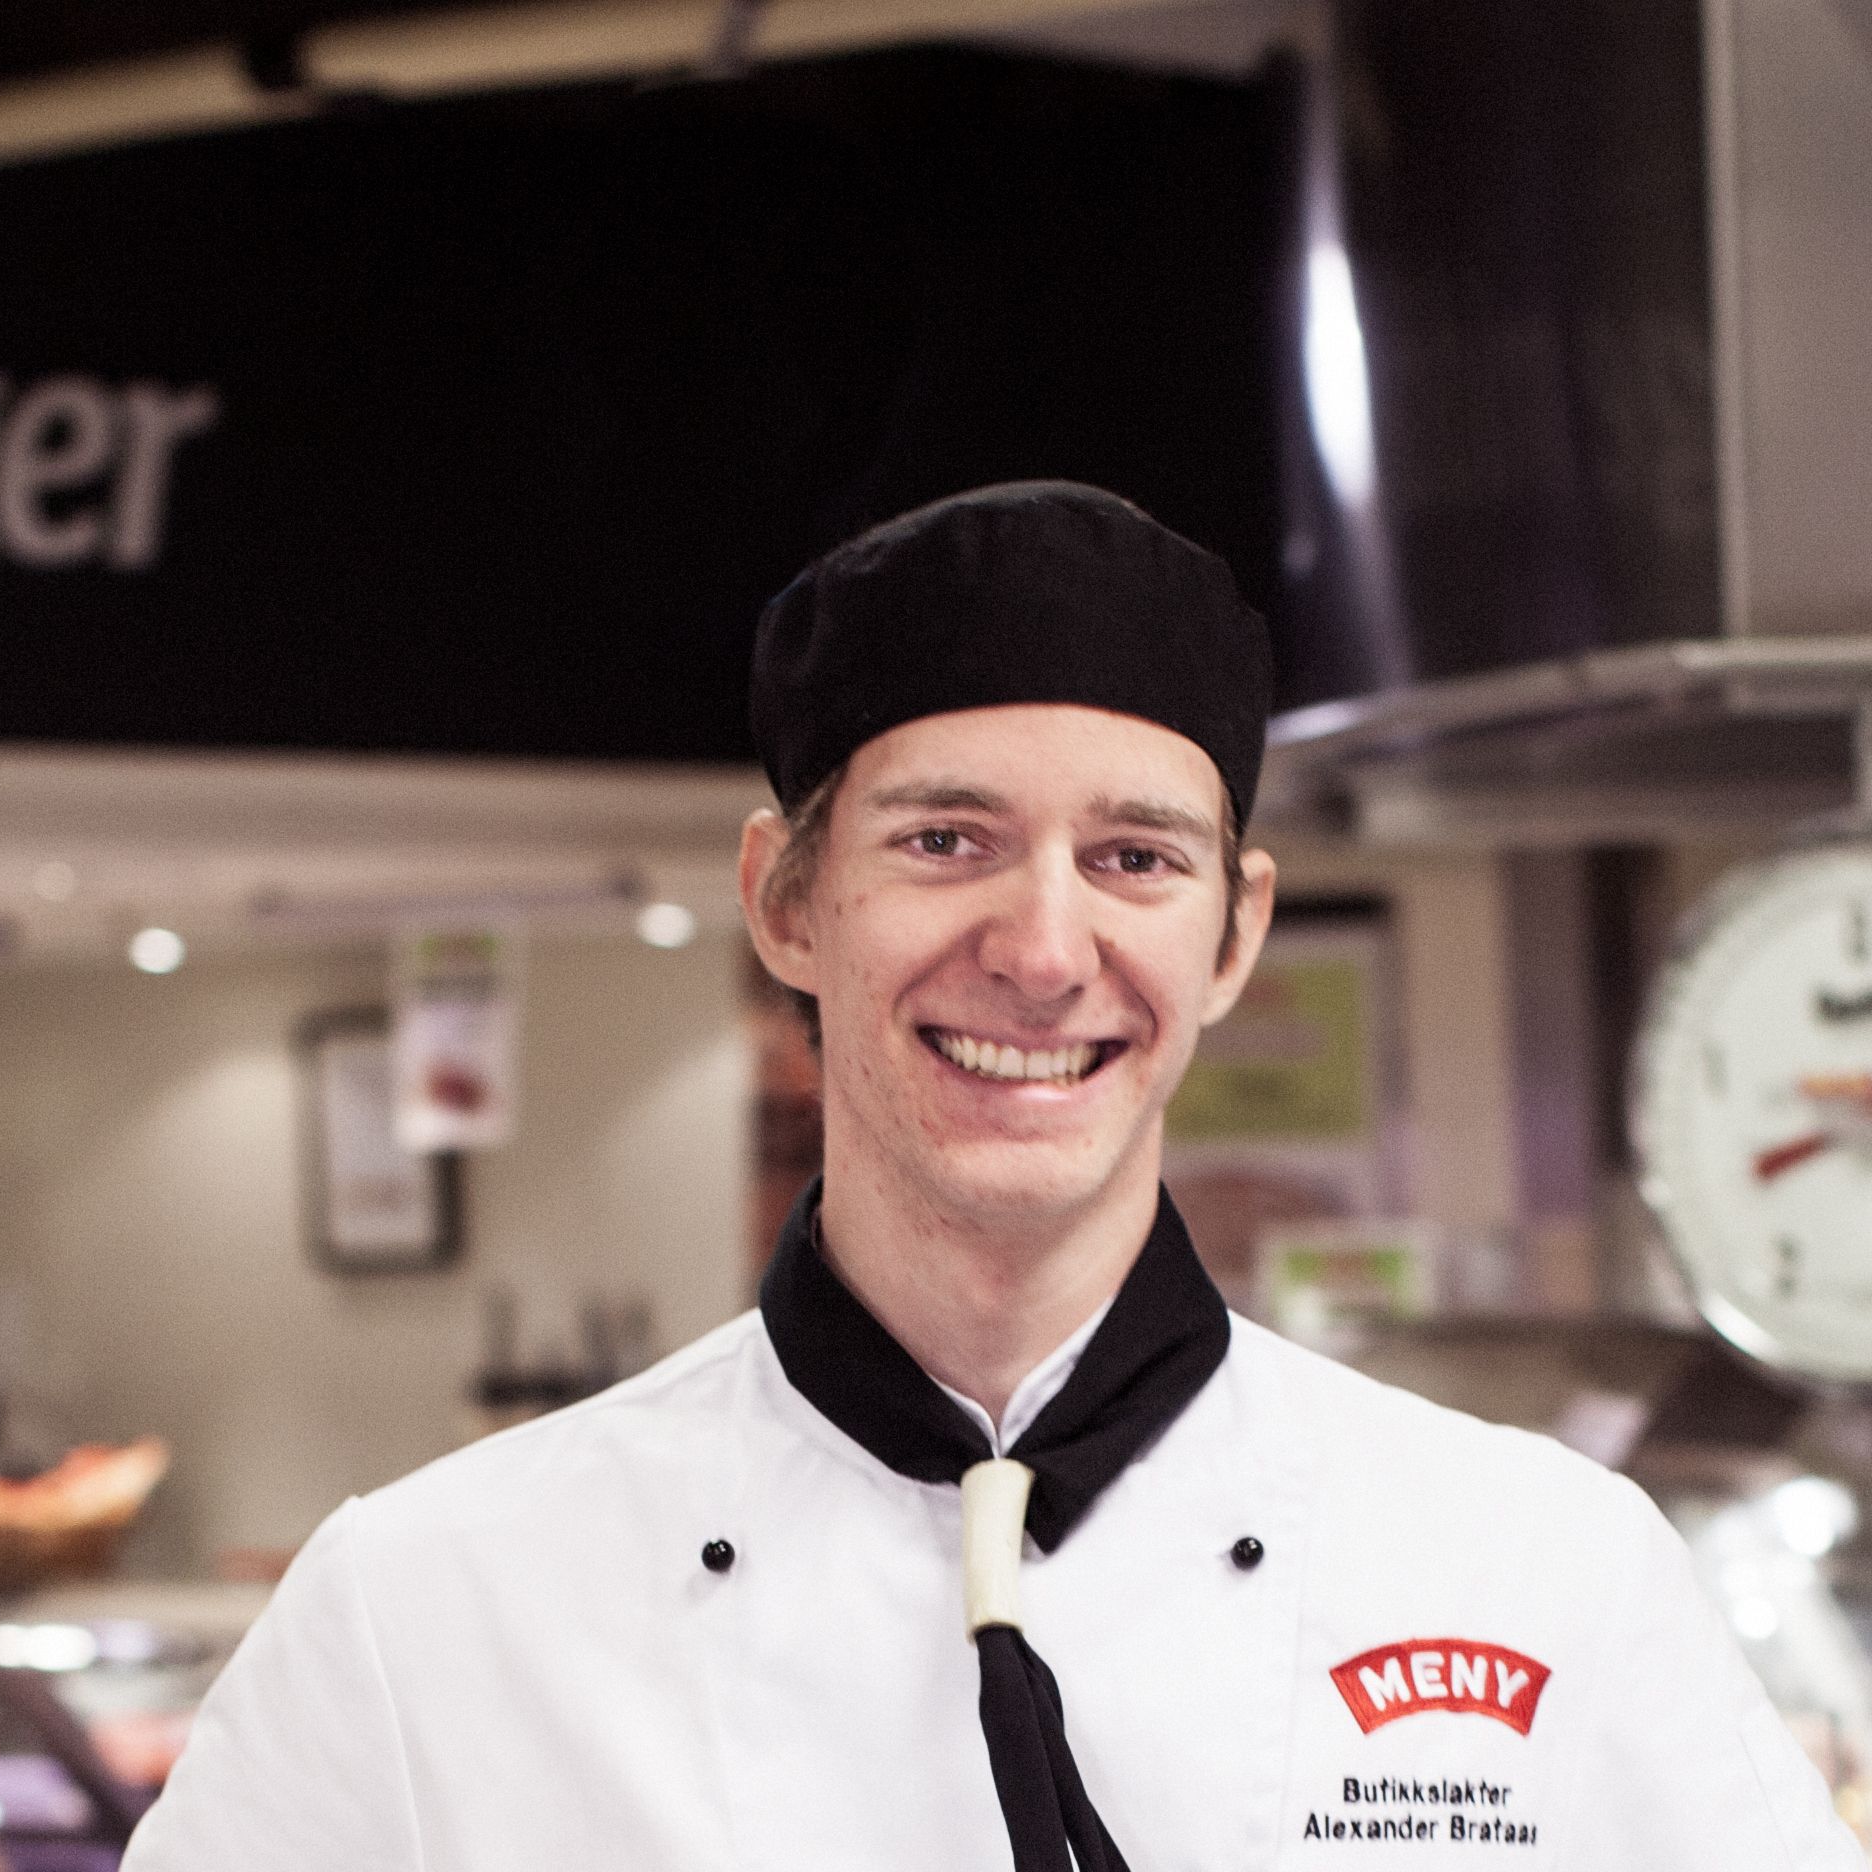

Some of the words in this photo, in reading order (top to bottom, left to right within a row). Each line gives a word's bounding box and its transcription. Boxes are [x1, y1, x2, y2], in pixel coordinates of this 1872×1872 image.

[1357, 1650, 1530, 1712] MENY
[1343, 1776, 1513, 1807] Butikkslakter
[1304, 1812, 1439, 1842] Alexander
